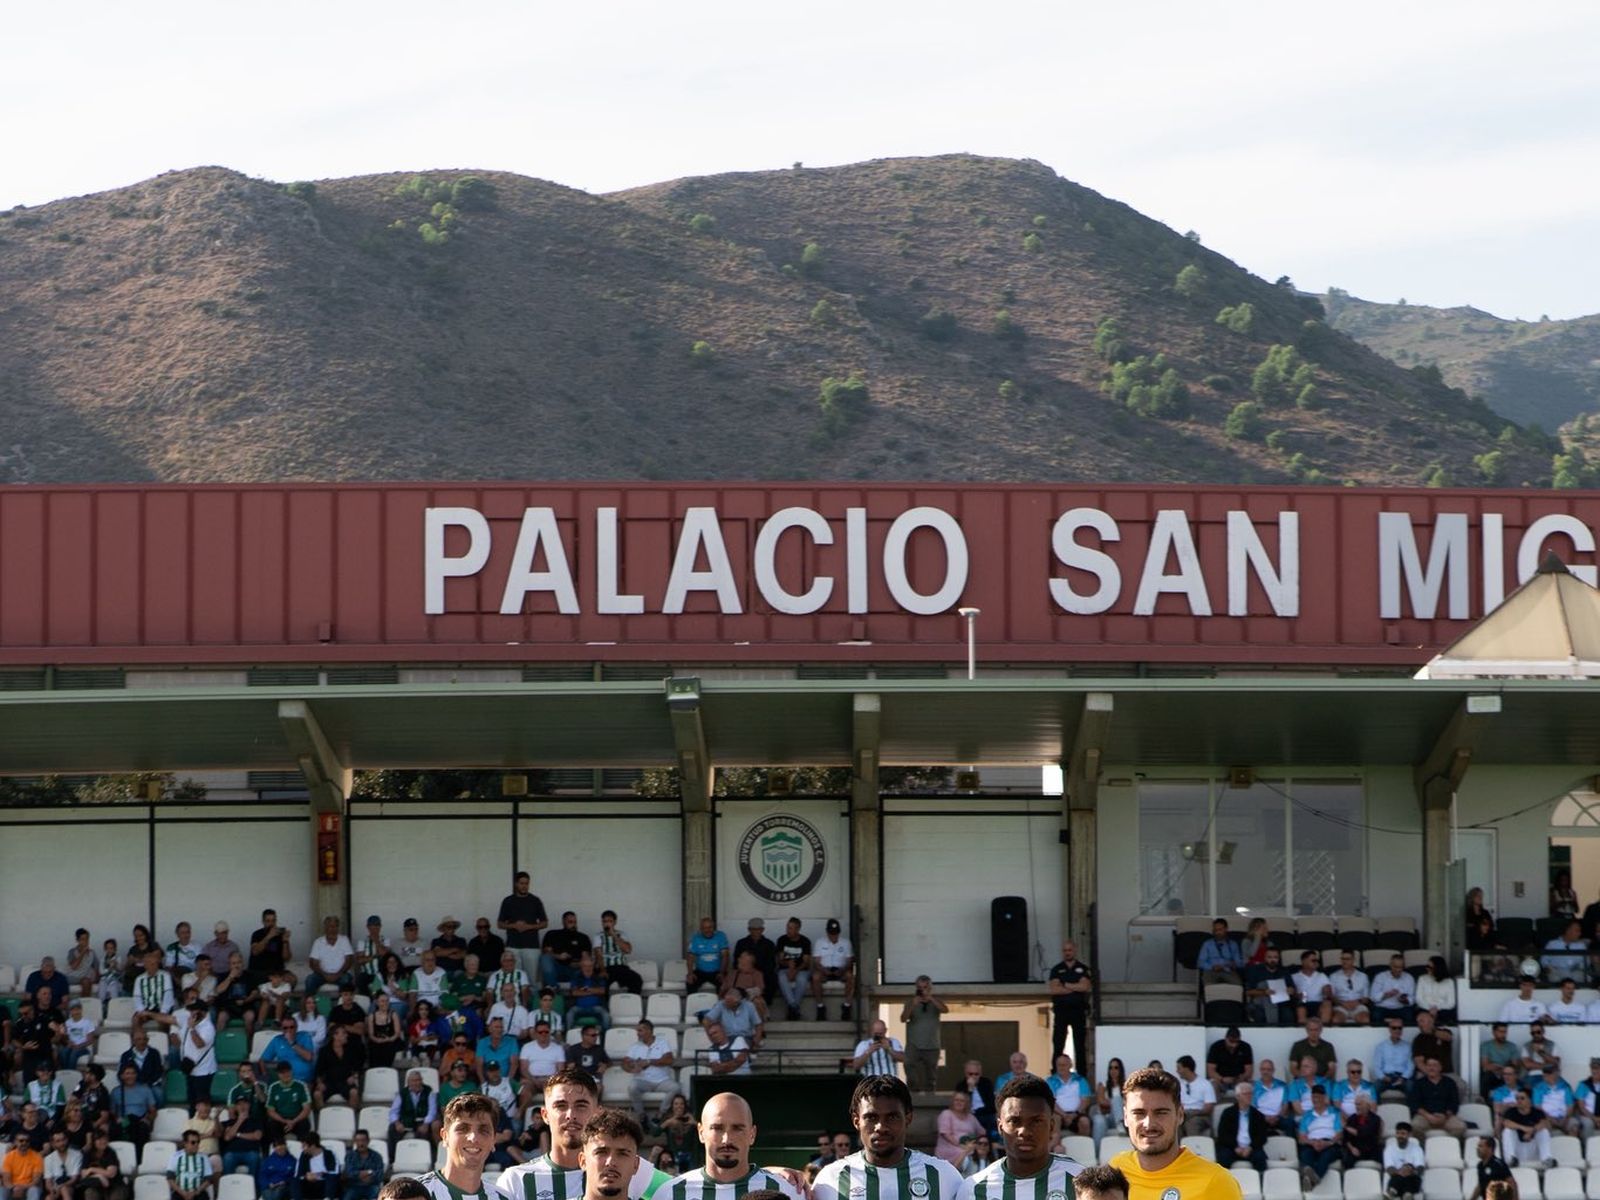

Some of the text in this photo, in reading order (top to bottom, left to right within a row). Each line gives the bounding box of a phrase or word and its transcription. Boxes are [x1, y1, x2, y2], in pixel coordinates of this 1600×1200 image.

[424, 506, 969, 615] PALACIO
[1048, 507, 1299, 617] SAN
[770, 891, 796, 901] 1958
